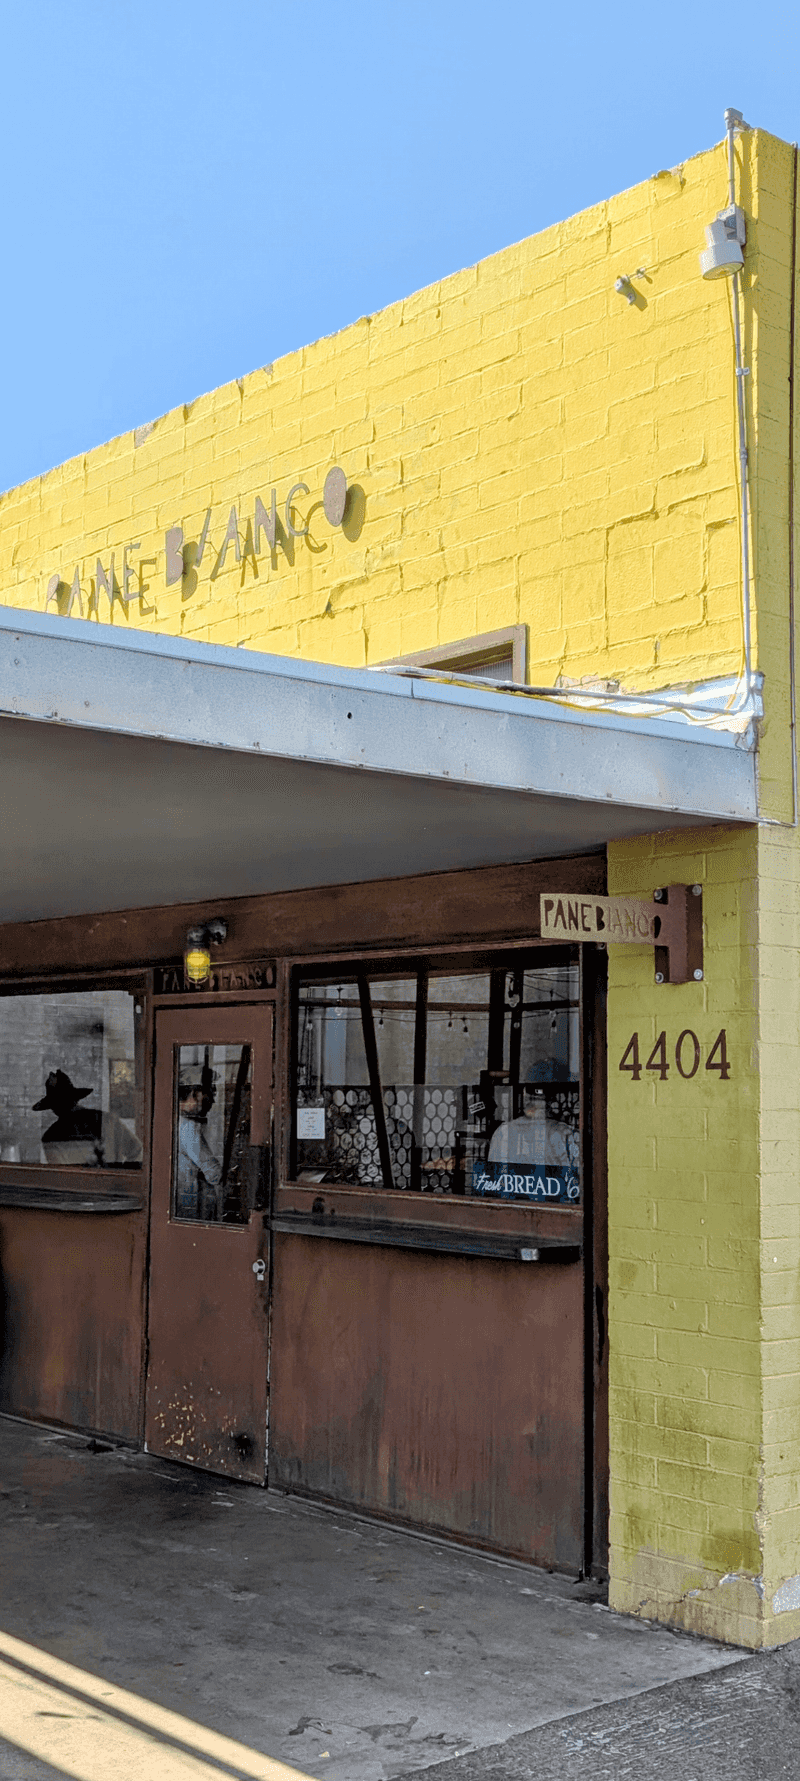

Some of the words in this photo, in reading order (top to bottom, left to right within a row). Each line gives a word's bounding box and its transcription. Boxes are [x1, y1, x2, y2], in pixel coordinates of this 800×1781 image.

[46, 542, 141, 616] PANE
[165, 466, 347, 587] BIANCO
[543, 898, 593, 932] PANE
[595, 905, 662, 939] BIANCO
[618, 1028, 731, 1081] 4404
[476, 1172, 504, 1192] Fresh
[502, 1173, 561, 1197] BREAD
